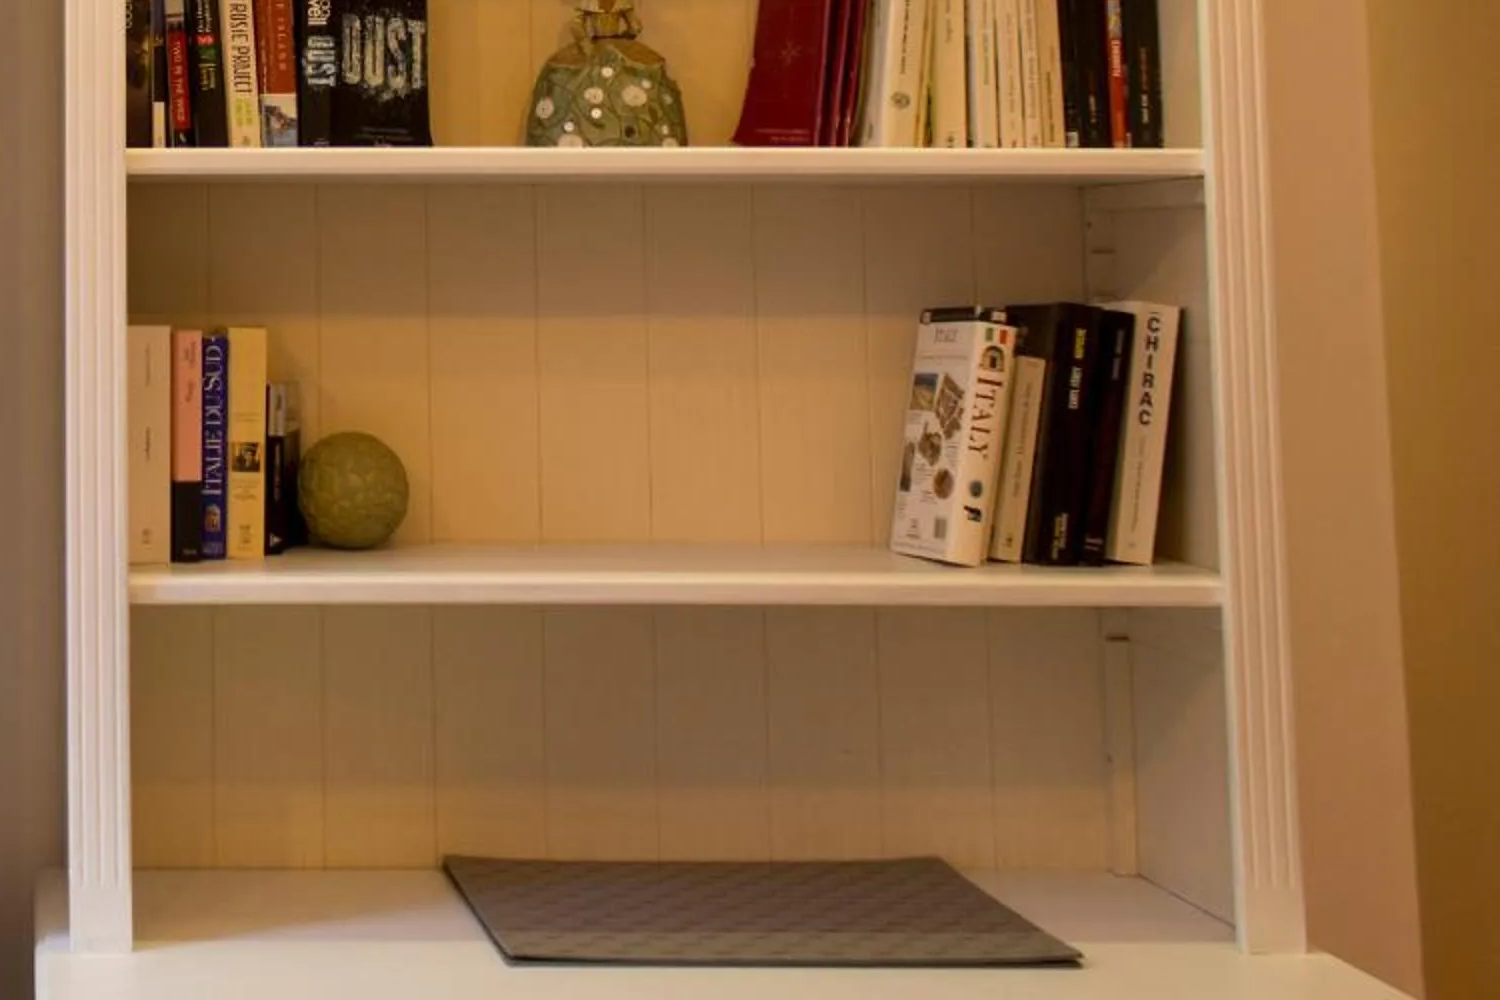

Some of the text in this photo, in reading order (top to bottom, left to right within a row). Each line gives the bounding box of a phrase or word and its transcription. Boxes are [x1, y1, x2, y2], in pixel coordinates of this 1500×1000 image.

[229, 3, 251, 42] ROSIE
[341, 13, 427, 89] DUST
[231, 45, 253, 94] PROJECT
[307, 34, 336, 88] DUST
[202, 345, 223, 392] SUD
[1139, 316, 1161, 426] CHIRAC
[967, 376, 1003, 454] ITALY
[202, 430, 223, 495] ITALIE
